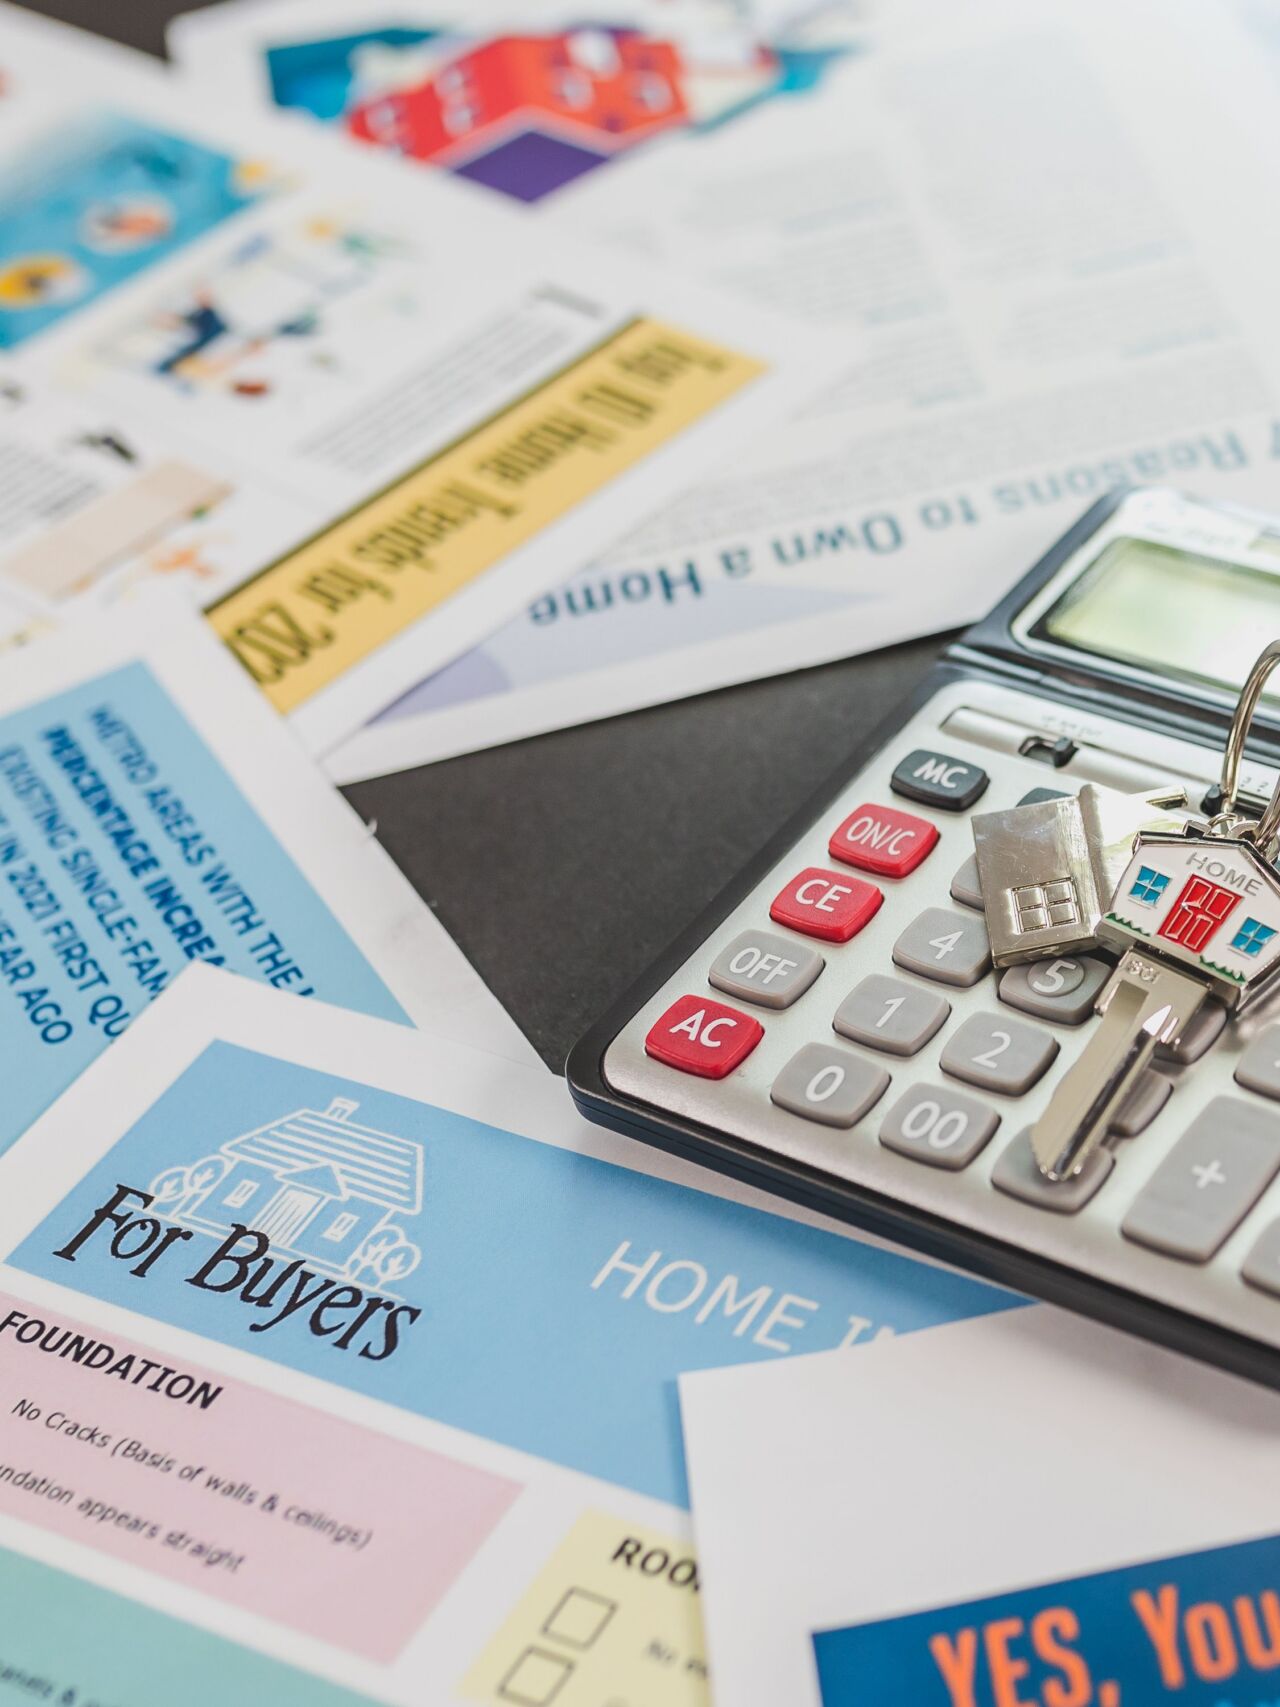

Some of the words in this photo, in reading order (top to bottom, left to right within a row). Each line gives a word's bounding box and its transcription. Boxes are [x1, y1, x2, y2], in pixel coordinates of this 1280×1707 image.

[480, 405, 622, 490] Home
[993, 428, 1247, 513] Reasons
[352, 478, 522, 574] Trends
[771, 512, 904, 565] Own
[919, 496, 978, 531] to
[297, 558, 393, 614] for
[719, 548, 752, 578] a
[528, 561, 705, 628] Home
[0, 745, 79, 852] EXISTING
[42, 724, 160, 878] PERCENTAGE
[912, 757, 974, 790] MC
[88, 705, 158, 786] METRO
[144, 783, 216, 868] AREAS
[202, 860, 265, 936] WITH
[249, 931, 304, 989] THE
[845, 816, 917, 858] ON/C
[794, 878, 853, 914] CE
[1185, 851, 1264, 897] HOME
[0, 922, 37, 987] EAR
[6, 862, 62, 925] 2021
[44, 918, 112, 993] FIRST
[929, 929, 966, 962] 4
[728, 946, 800, 985] OFF
[1032, 958, 1079, 995] 5
[18, 985, 74, 1045] AGO
[668, 1008, 739, 1050] AC
[874, 995, 910, 1029] 1
[971, 1031, 1014, 1069] 2
[804, 1063, 847, 1105] 0
[900, 1103, 971, 1150] 00
[52, 1183, 193, 1278] For
[184, 1223, 421, 1361] Buyers
[591, 1240, 820, 1352] HOME
[0, 1310, 224, 1410] FOUNDATION
[12, 1397, 41, 1422] No
[45, 1411, 112, 1449] Cracks
[111, 1437, 173, 1475] (Basis
[179, 1465, 206, 1483] of
[206, 1473, 256, 1507] walls
[259, 1493, 280, 1514] &
[284, 1502, 374, 1551] ceilings)
[77, 1496, 162, 1541] appears
[164, 1529, 247, 1573] straight
[611, 1536, 701, 1593] ROO
[928, 1606, 1120, 1707] YES,
